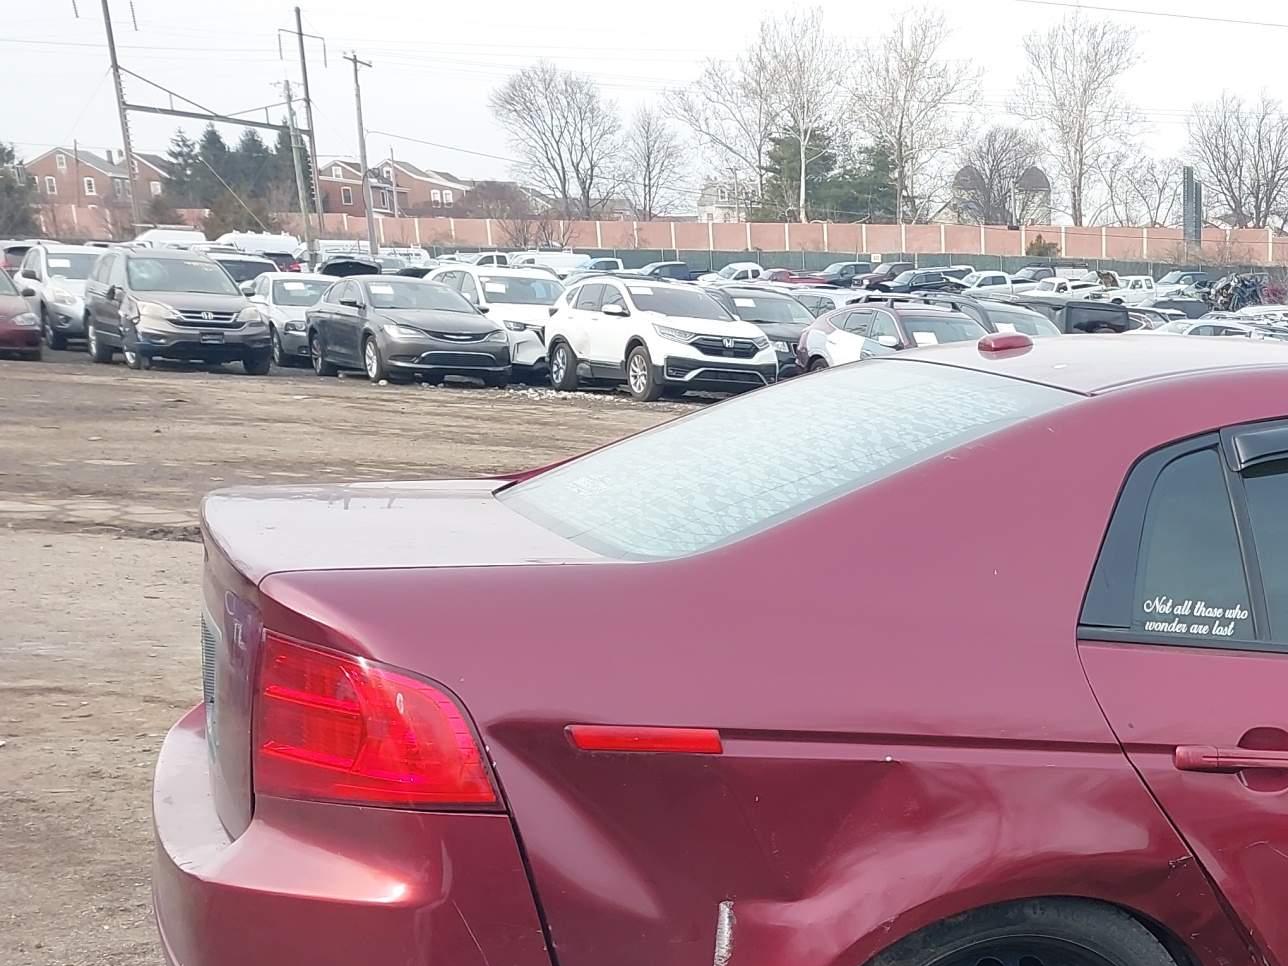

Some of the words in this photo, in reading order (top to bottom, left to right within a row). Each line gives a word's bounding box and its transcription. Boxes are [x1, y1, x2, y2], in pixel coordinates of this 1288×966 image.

[1143, 596, 1172, 614] Not
[1174, 600, 1192, 615] all
[1193, 601, 1224, 617] those
[1225, 605, 1248, 619] who
[1145, 618, 1187, 633] wonder
[1190, 624, 1210, 635] are
[1212, 620, 1235, 636] lost
